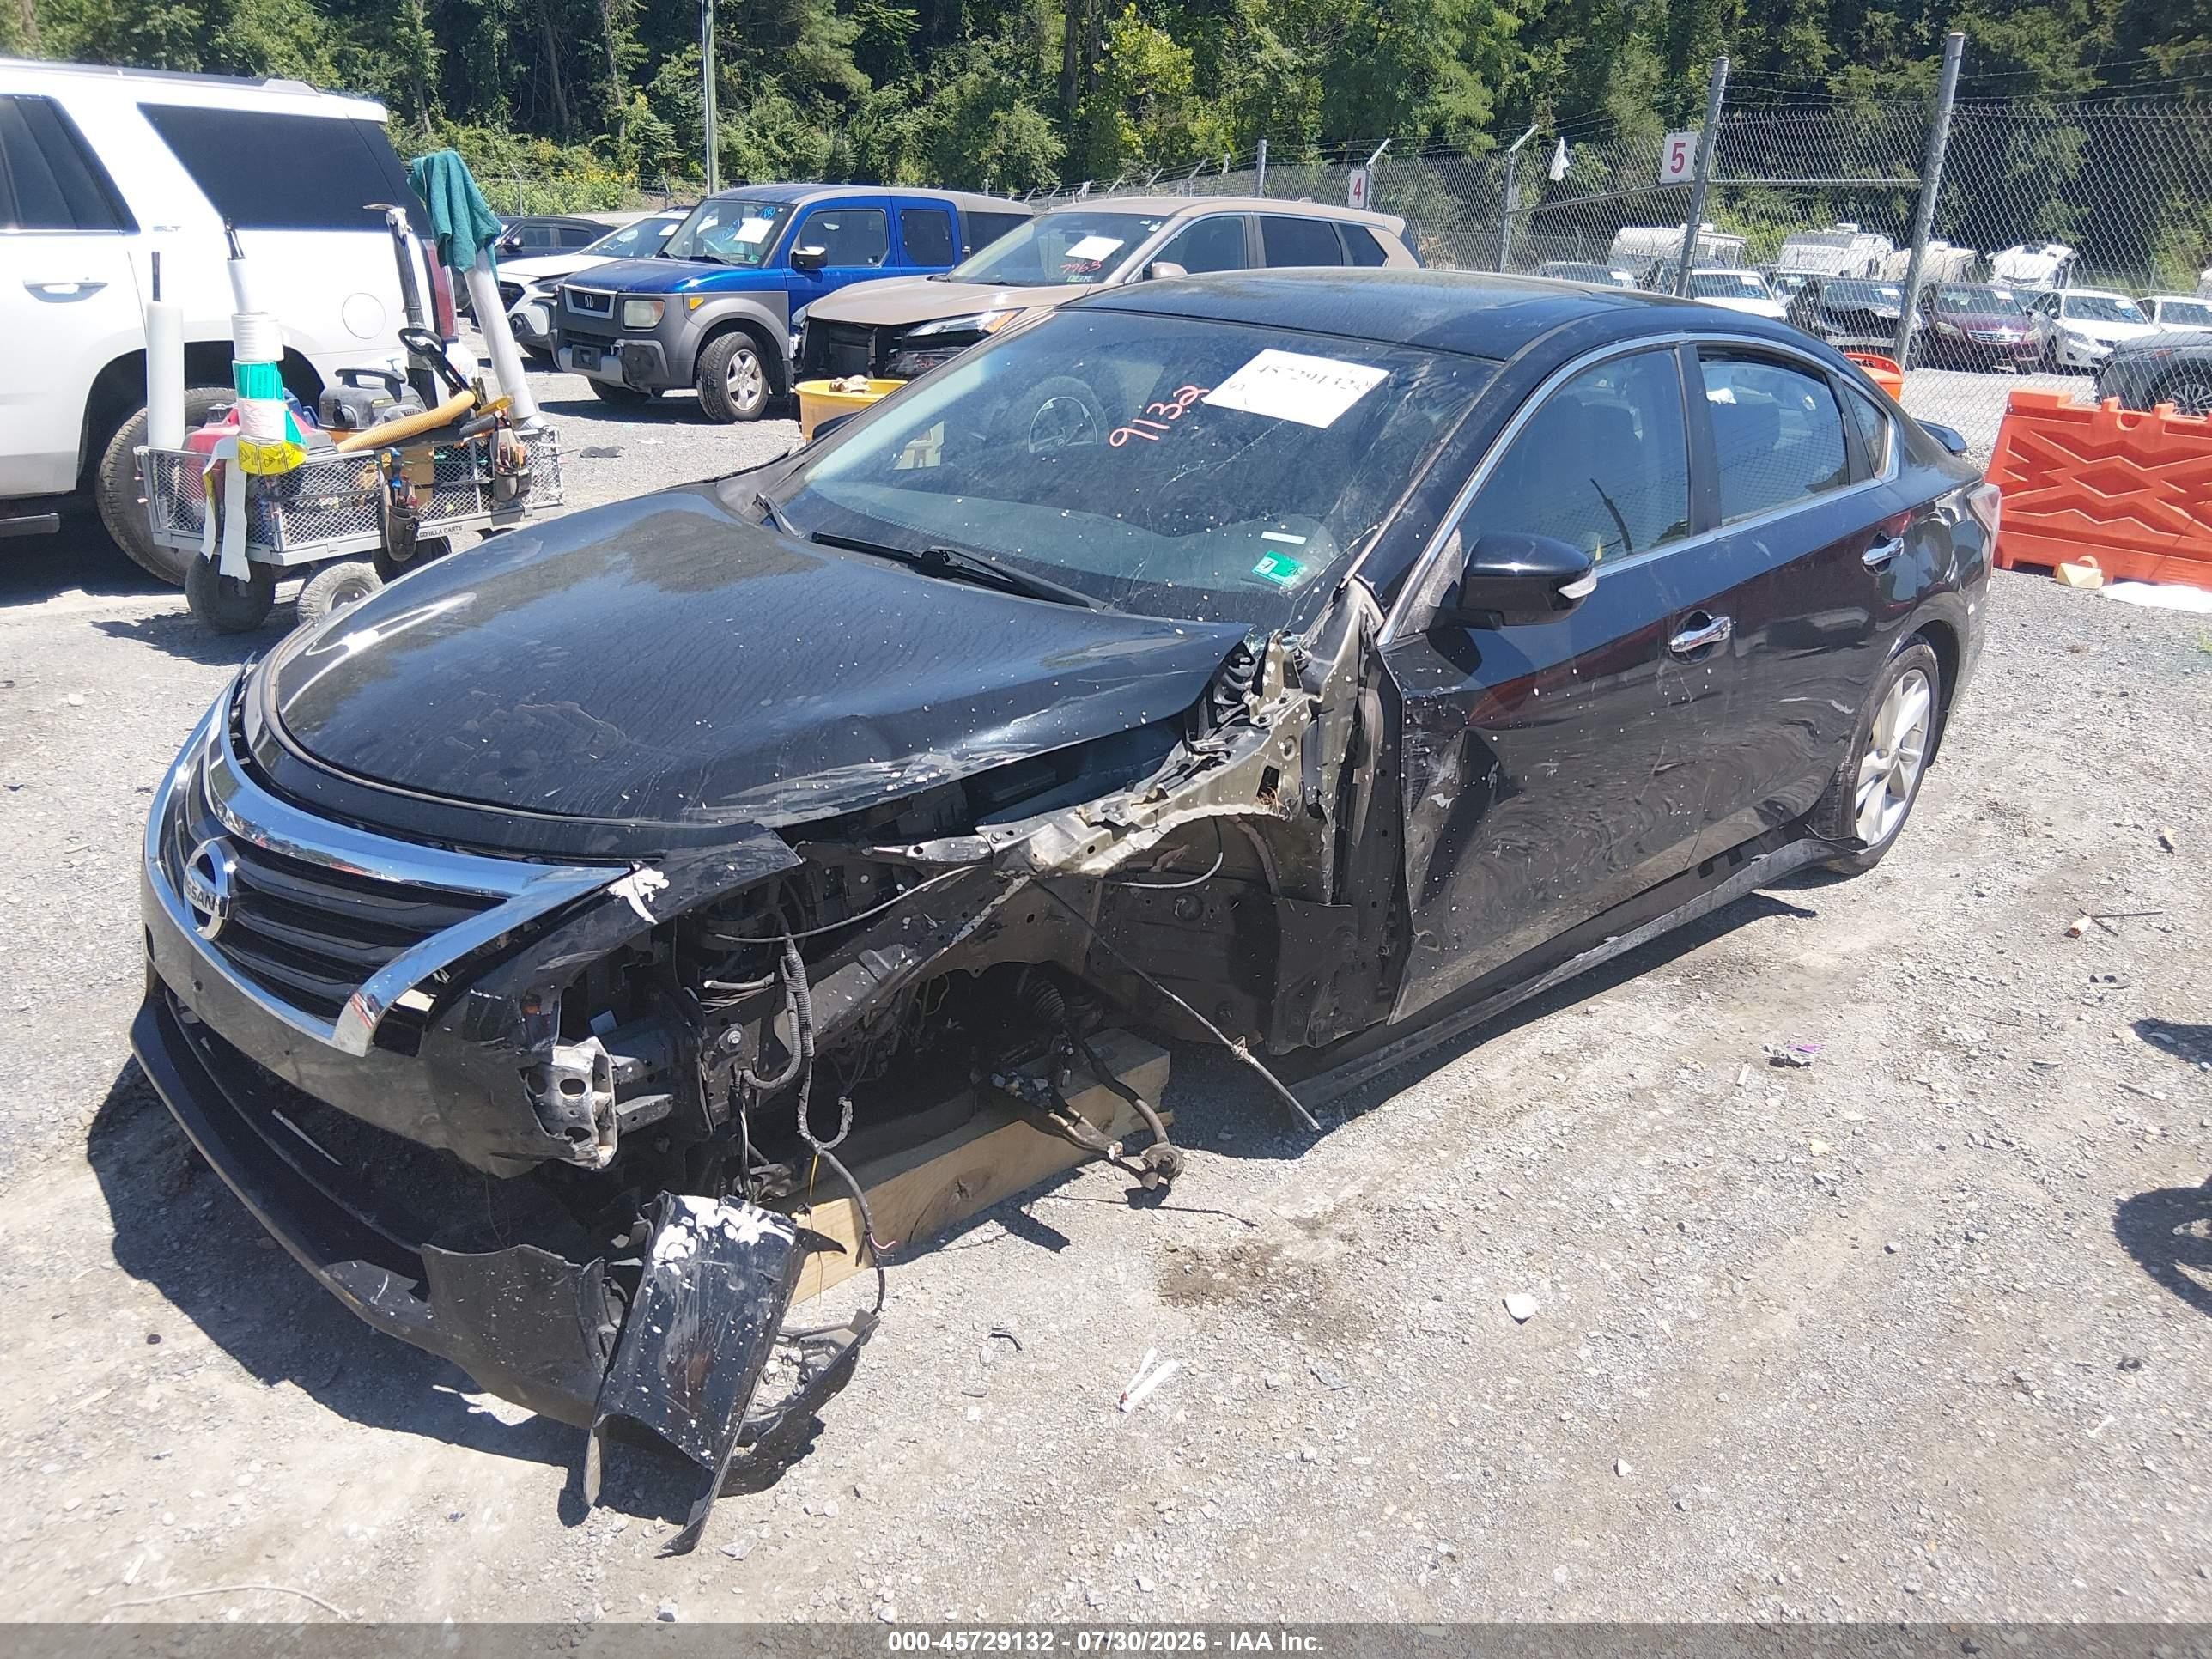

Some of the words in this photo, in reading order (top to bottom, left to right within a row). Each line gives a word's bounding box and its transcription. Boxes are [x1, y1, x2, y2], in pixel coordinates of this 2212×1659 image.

[1670, 142, 1686, 174] 5
[1352, 177, 1362, 202] 4
[1109, 384, 1210, 448] 9132
[419, 529, 444, 538] GORILLA
[443, 525, 463, 534] CARTS
[185, 874, 216, 912] ISSAN
